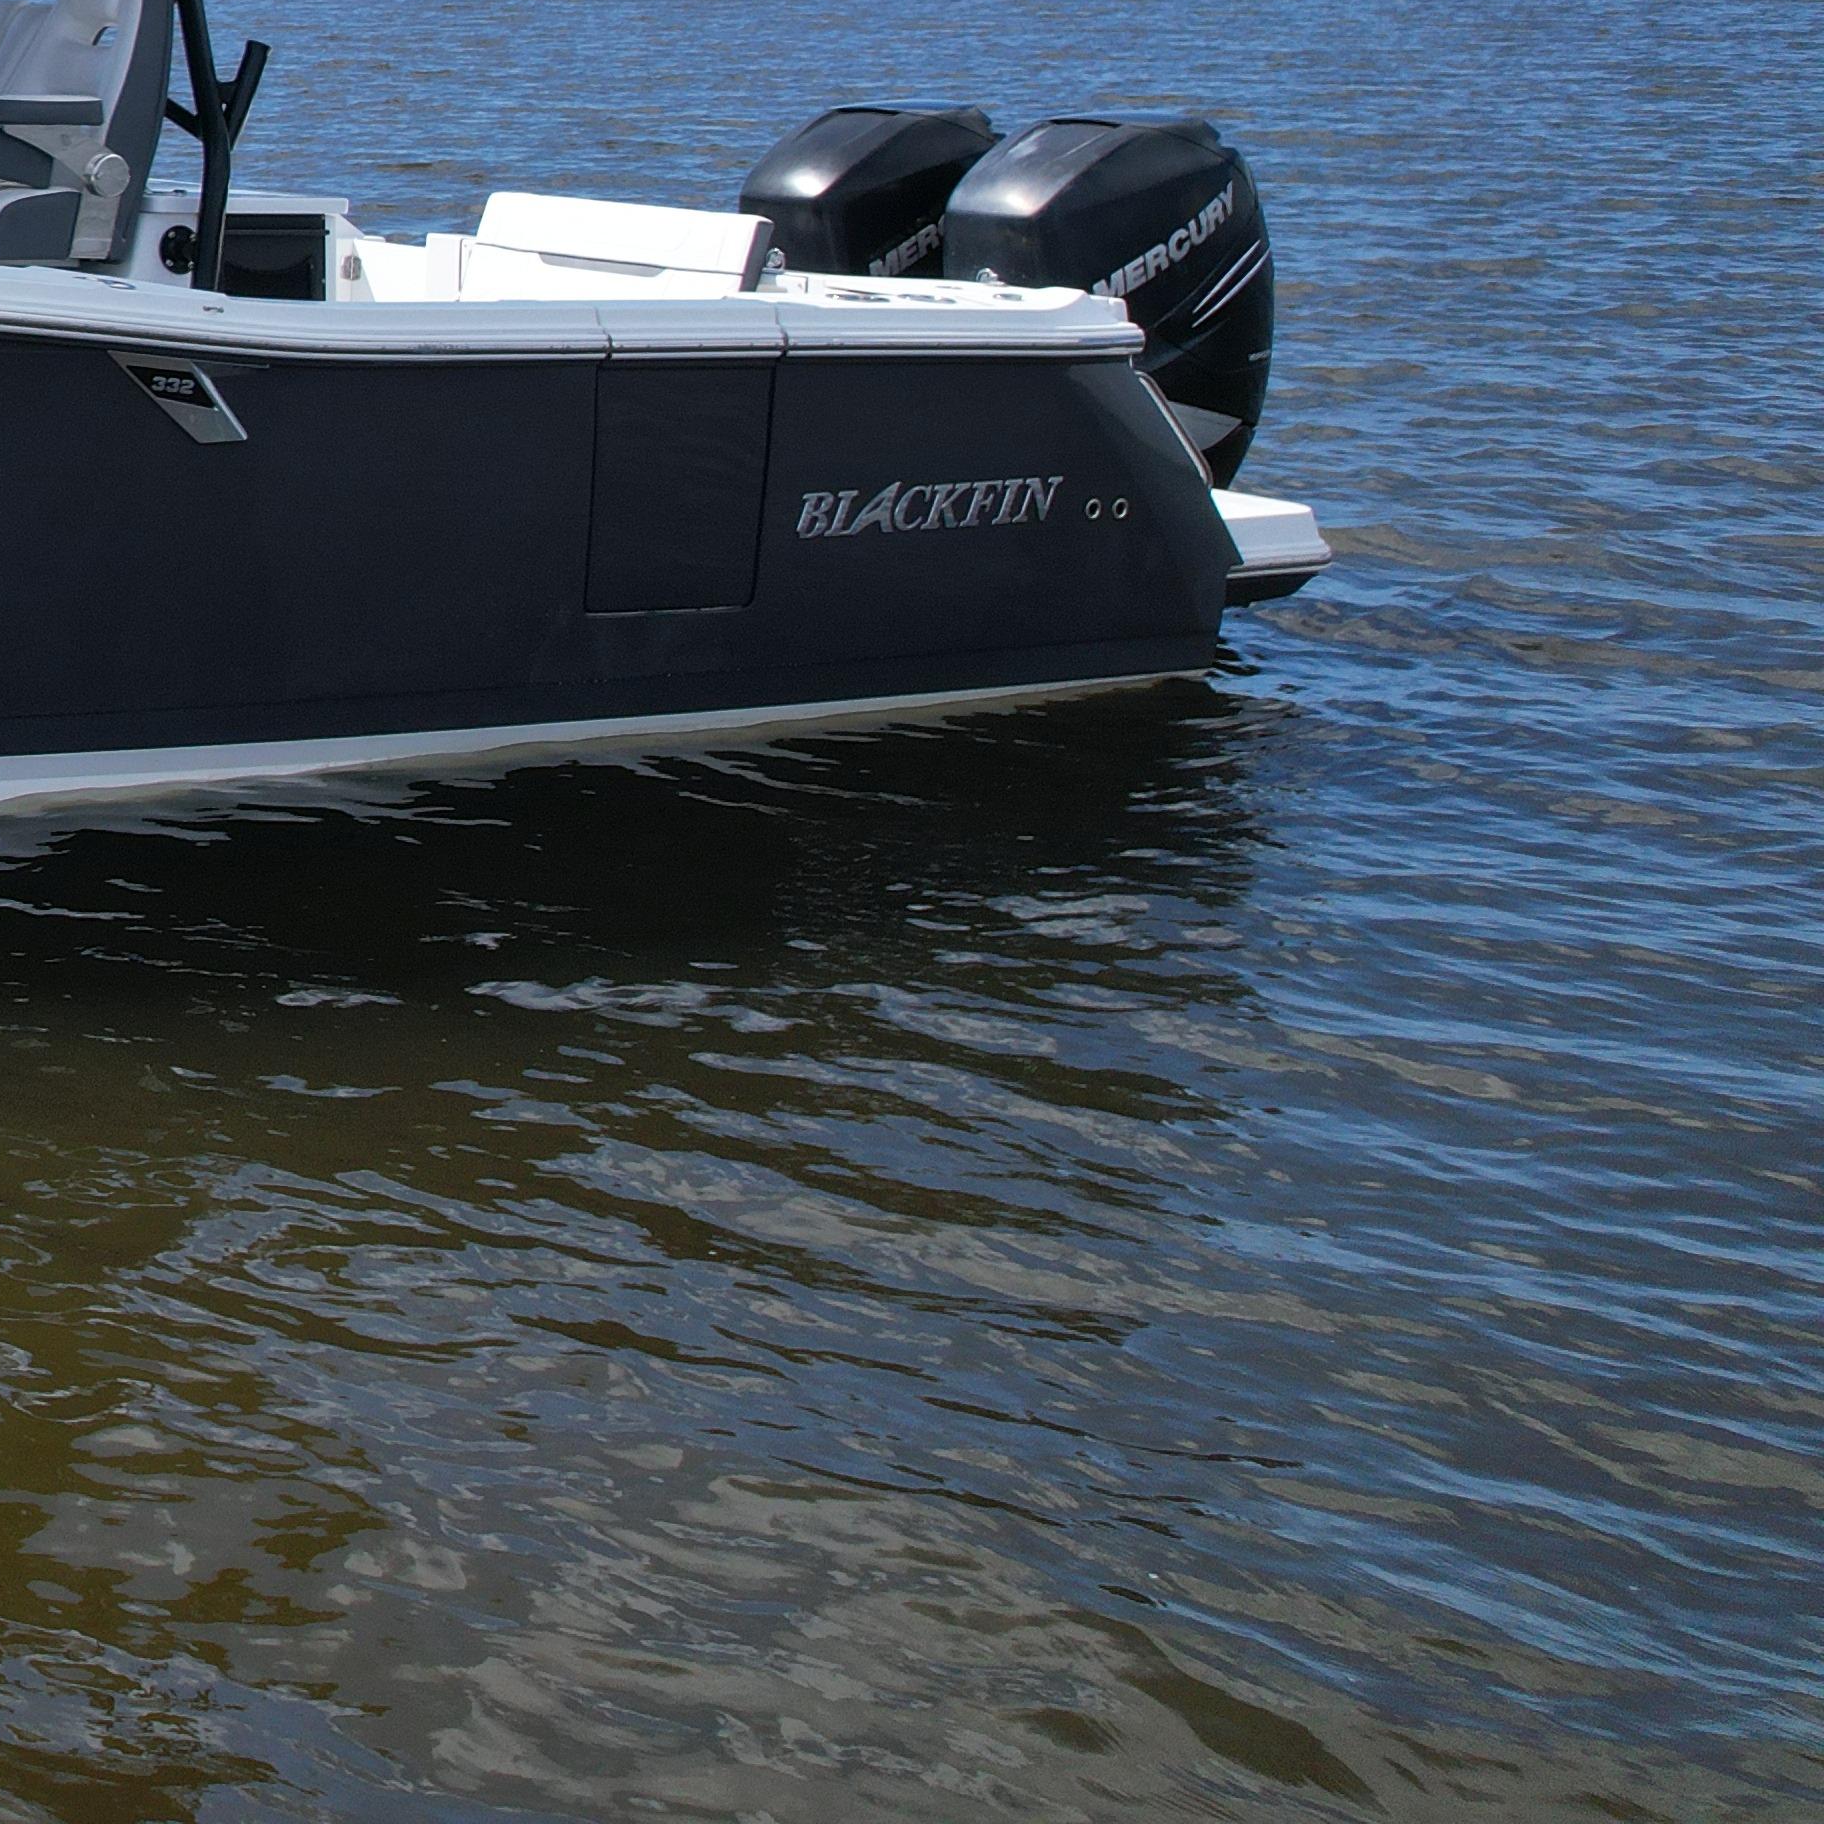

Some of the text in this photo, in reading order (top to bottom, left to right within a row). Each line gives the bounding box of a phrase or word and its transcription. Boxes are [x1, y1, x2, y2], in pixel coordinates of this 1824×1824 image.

[1092, 179, 1233, 298] MERCURY
[151, 376, 195, 395] 332
[796, 476, 1064, 539] BLACKFIN
